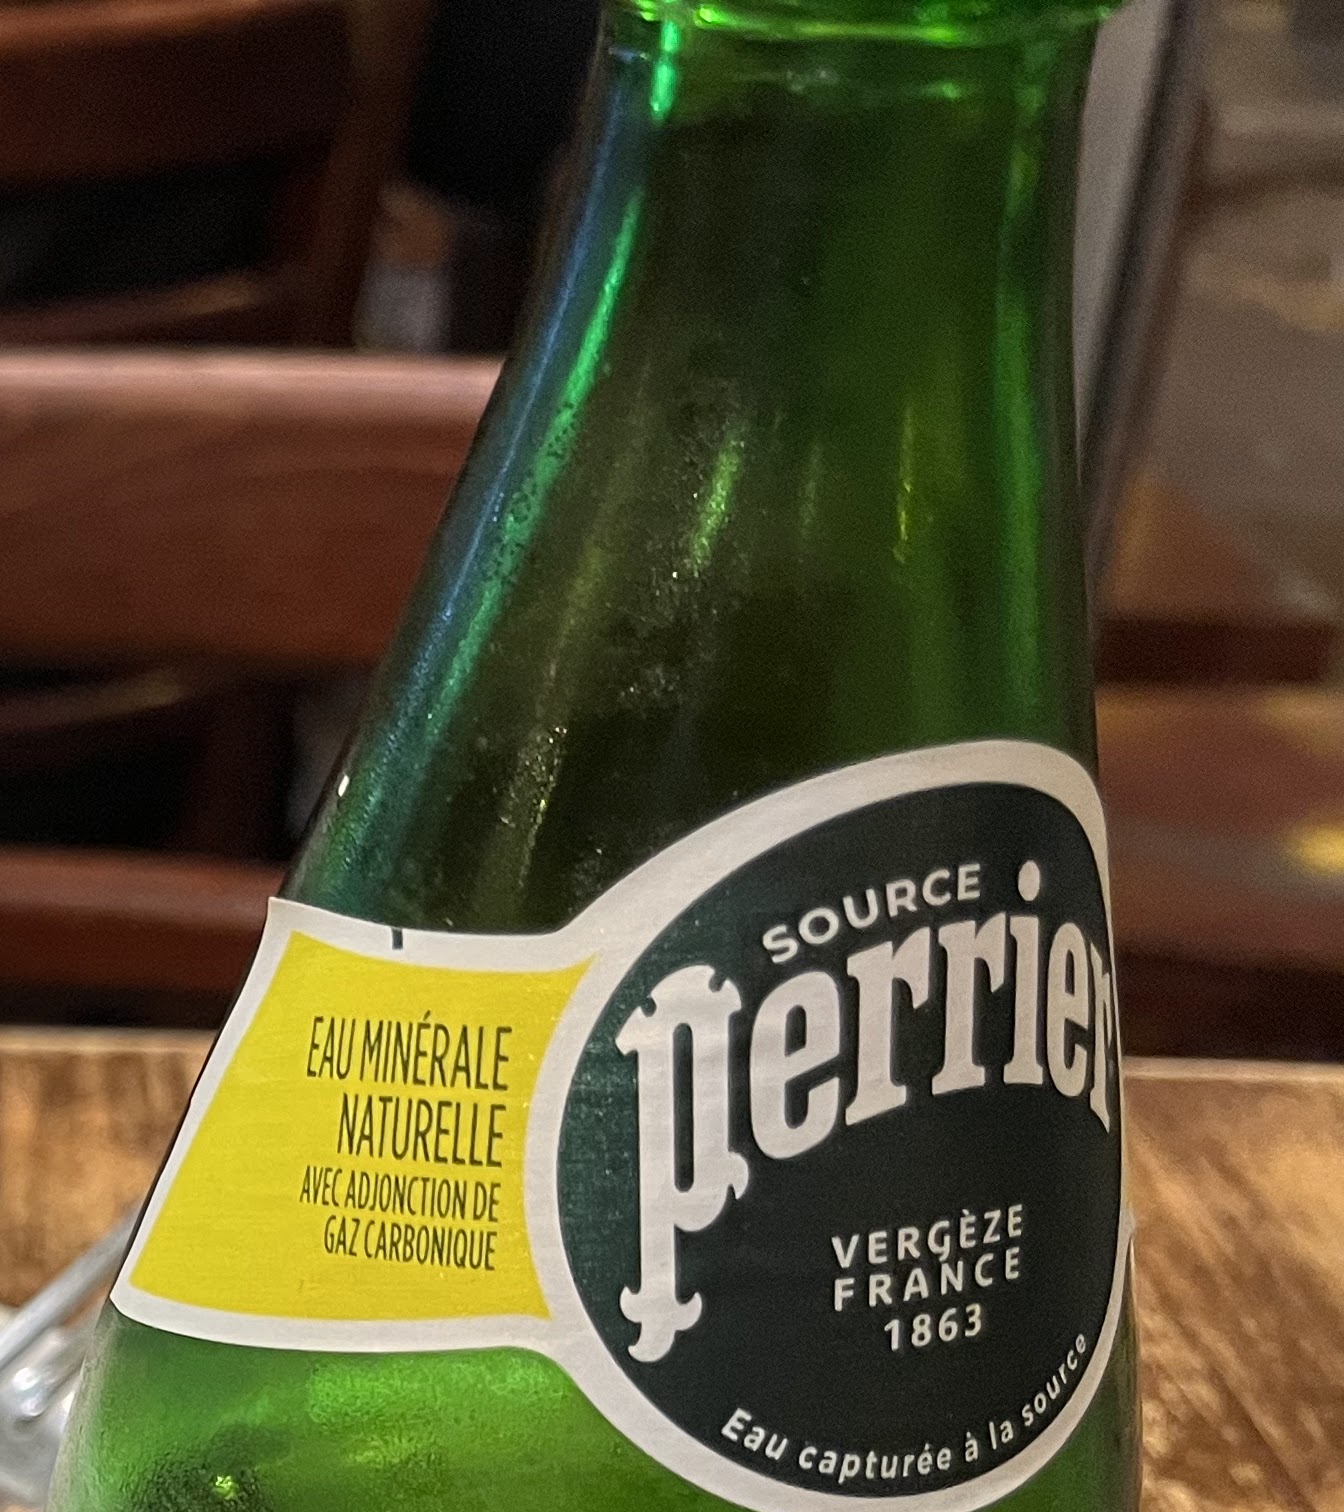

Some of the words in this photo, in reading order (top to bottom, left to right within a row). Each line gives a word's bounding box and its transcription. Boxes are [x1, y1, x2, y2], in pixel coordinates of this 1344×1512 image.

[762, 862, 981, 964] SOURCE
[306, 1015, 357, 1080] EAU
[359, 1009, 513, 1091] MINÉRALE
[337, 1092, 507, 1168] NATURELLE
[299, 1165, 343, 1207] AVEC
[344, 1169, 468, 1221] ADJONCTION
[472, 1181, 502, 1223] DE
[324, 1214, 361, 1257] GAZ
[364, 1219, 498, 1271] CARBONIQUE
[831, 1203, 1024, 1269] VERGÈZE
[833, 1246, 1021, 1312] FRANCE
[884, 1303, 983, 1351] 1863
[720, 1407, 789, 1461] Eau
[798, 1443, 952, 1484] capturée
[964, 1432, 979, 1463] à
[989, 1421, 1014, 1450] la
[1021, 1333, 1086, 1427] source
